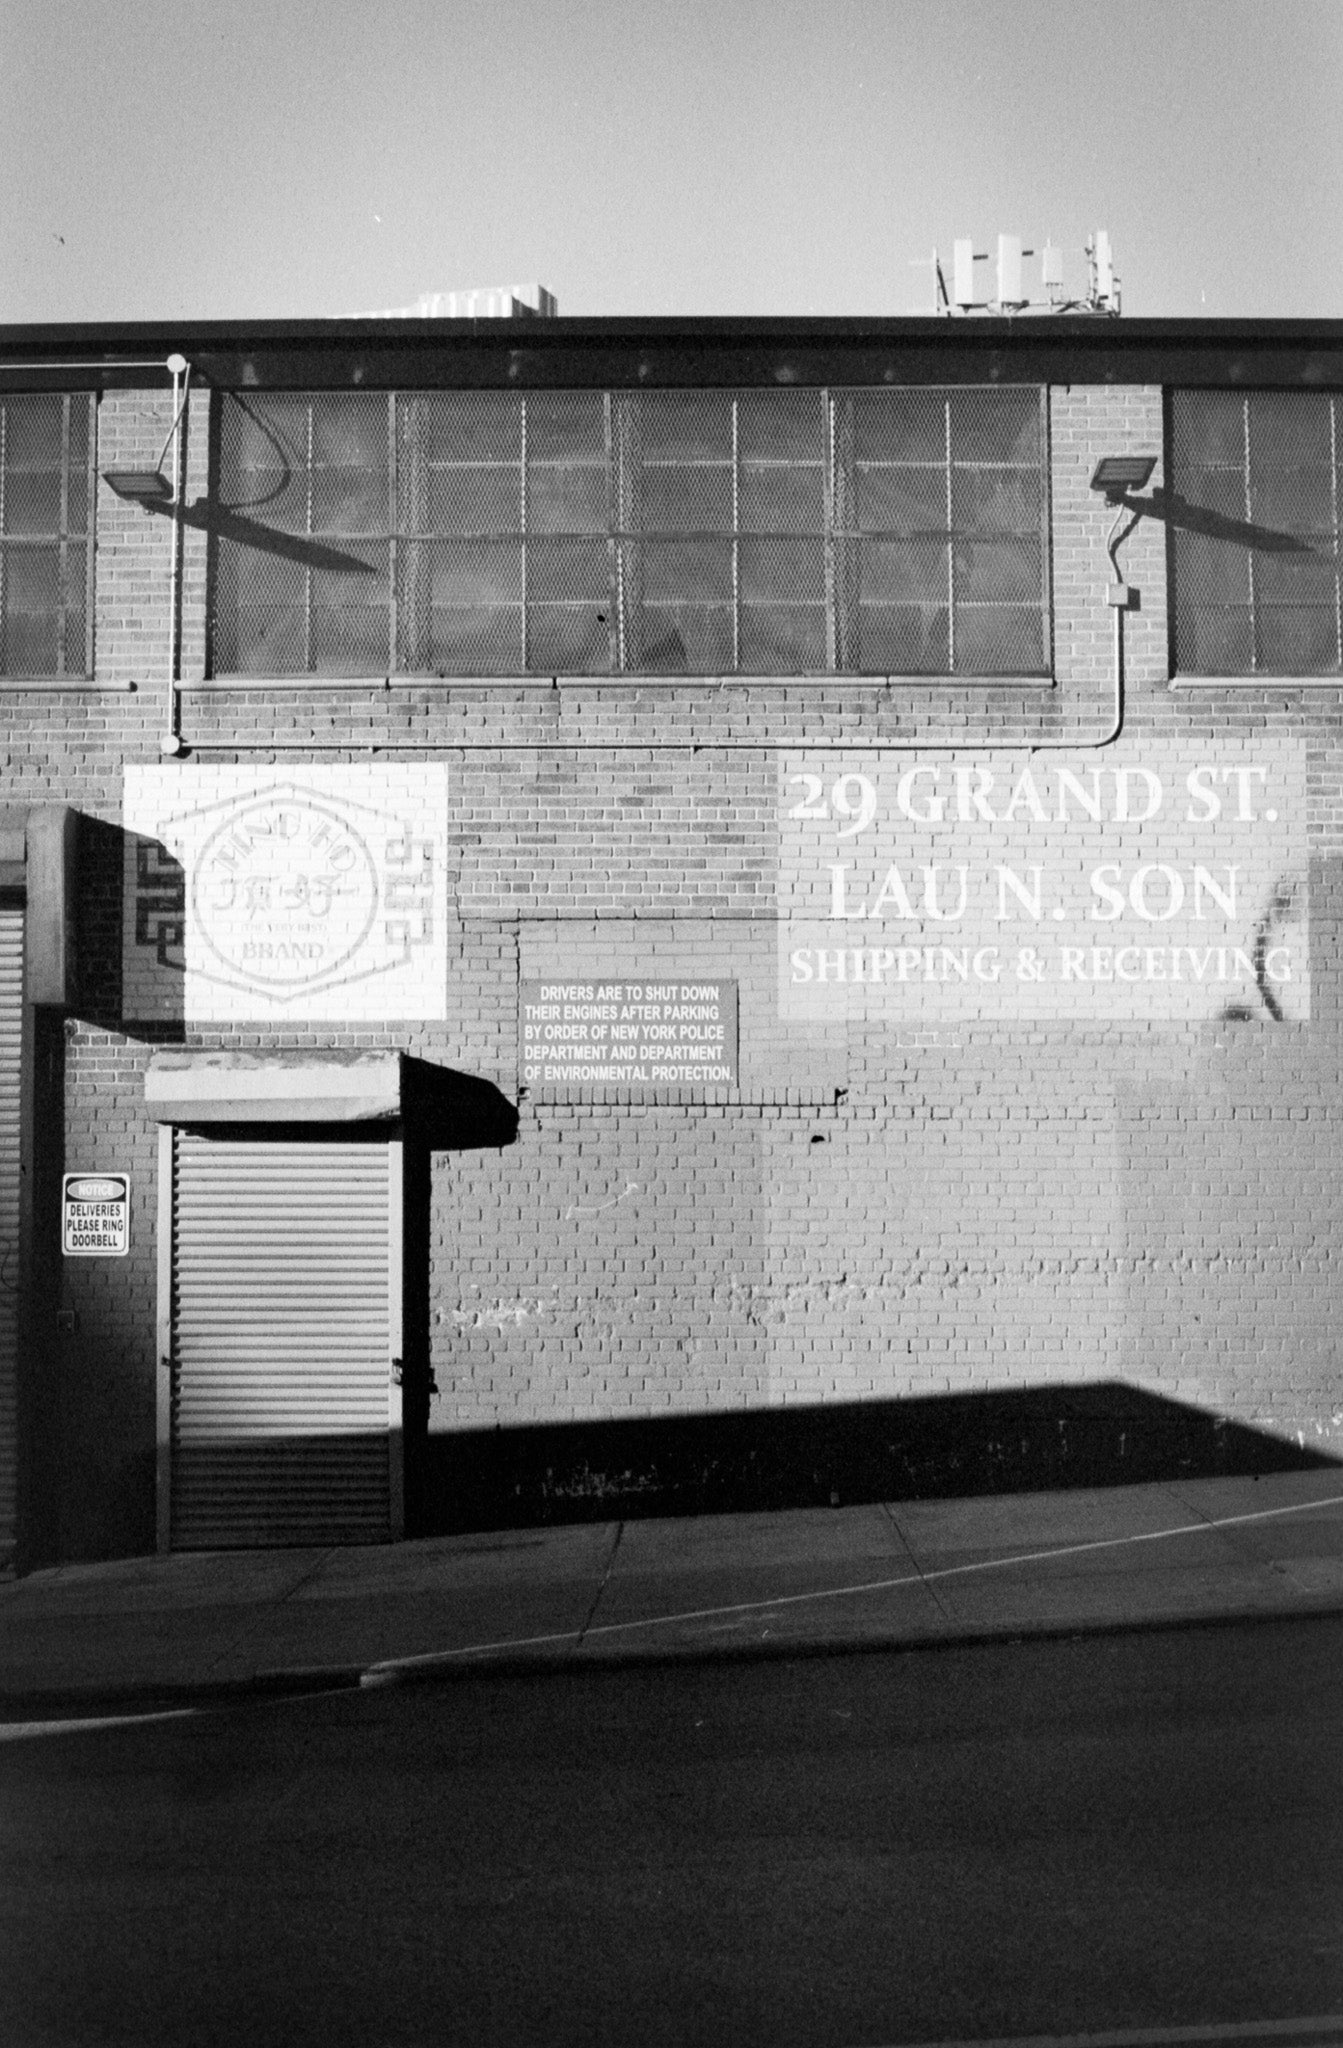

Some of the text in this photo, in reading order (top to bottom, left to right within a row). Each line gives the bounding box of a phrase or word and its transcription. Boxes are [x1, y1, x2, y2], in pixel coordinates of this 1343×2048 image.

[788, 765, 1279, 838] 29 GRAND ST.
[827, 863, 1240, 921] LAU N. SON
[243, 941, 325, 960] BRAND
[791, 946, 1293, 983] SHIPPING & RECEIVING
[540, 985, 719, 1001] DRIVERS ARE TO SHUT DOWN
[525, 1005, 719, 1020] THEIR ENGINES AFTER PARKING
[524, 1025, 725, 1040] BY ORDER OF NEW YORK POLICE
[524, 1045, 723, 1060] DEPARTMENT AND DEPARTMENT
[524, 1065, 734, 1081] OF ENVIRONMENTAL PROTECTION.
[78, 1183, 114, 1197] NOTICE
[70, 1204, 121, 1217] DELIVERIES
[67, 1219, 124, 1232] PLEASE RING
[72, 1234, 118, 1247] DOORBELL
